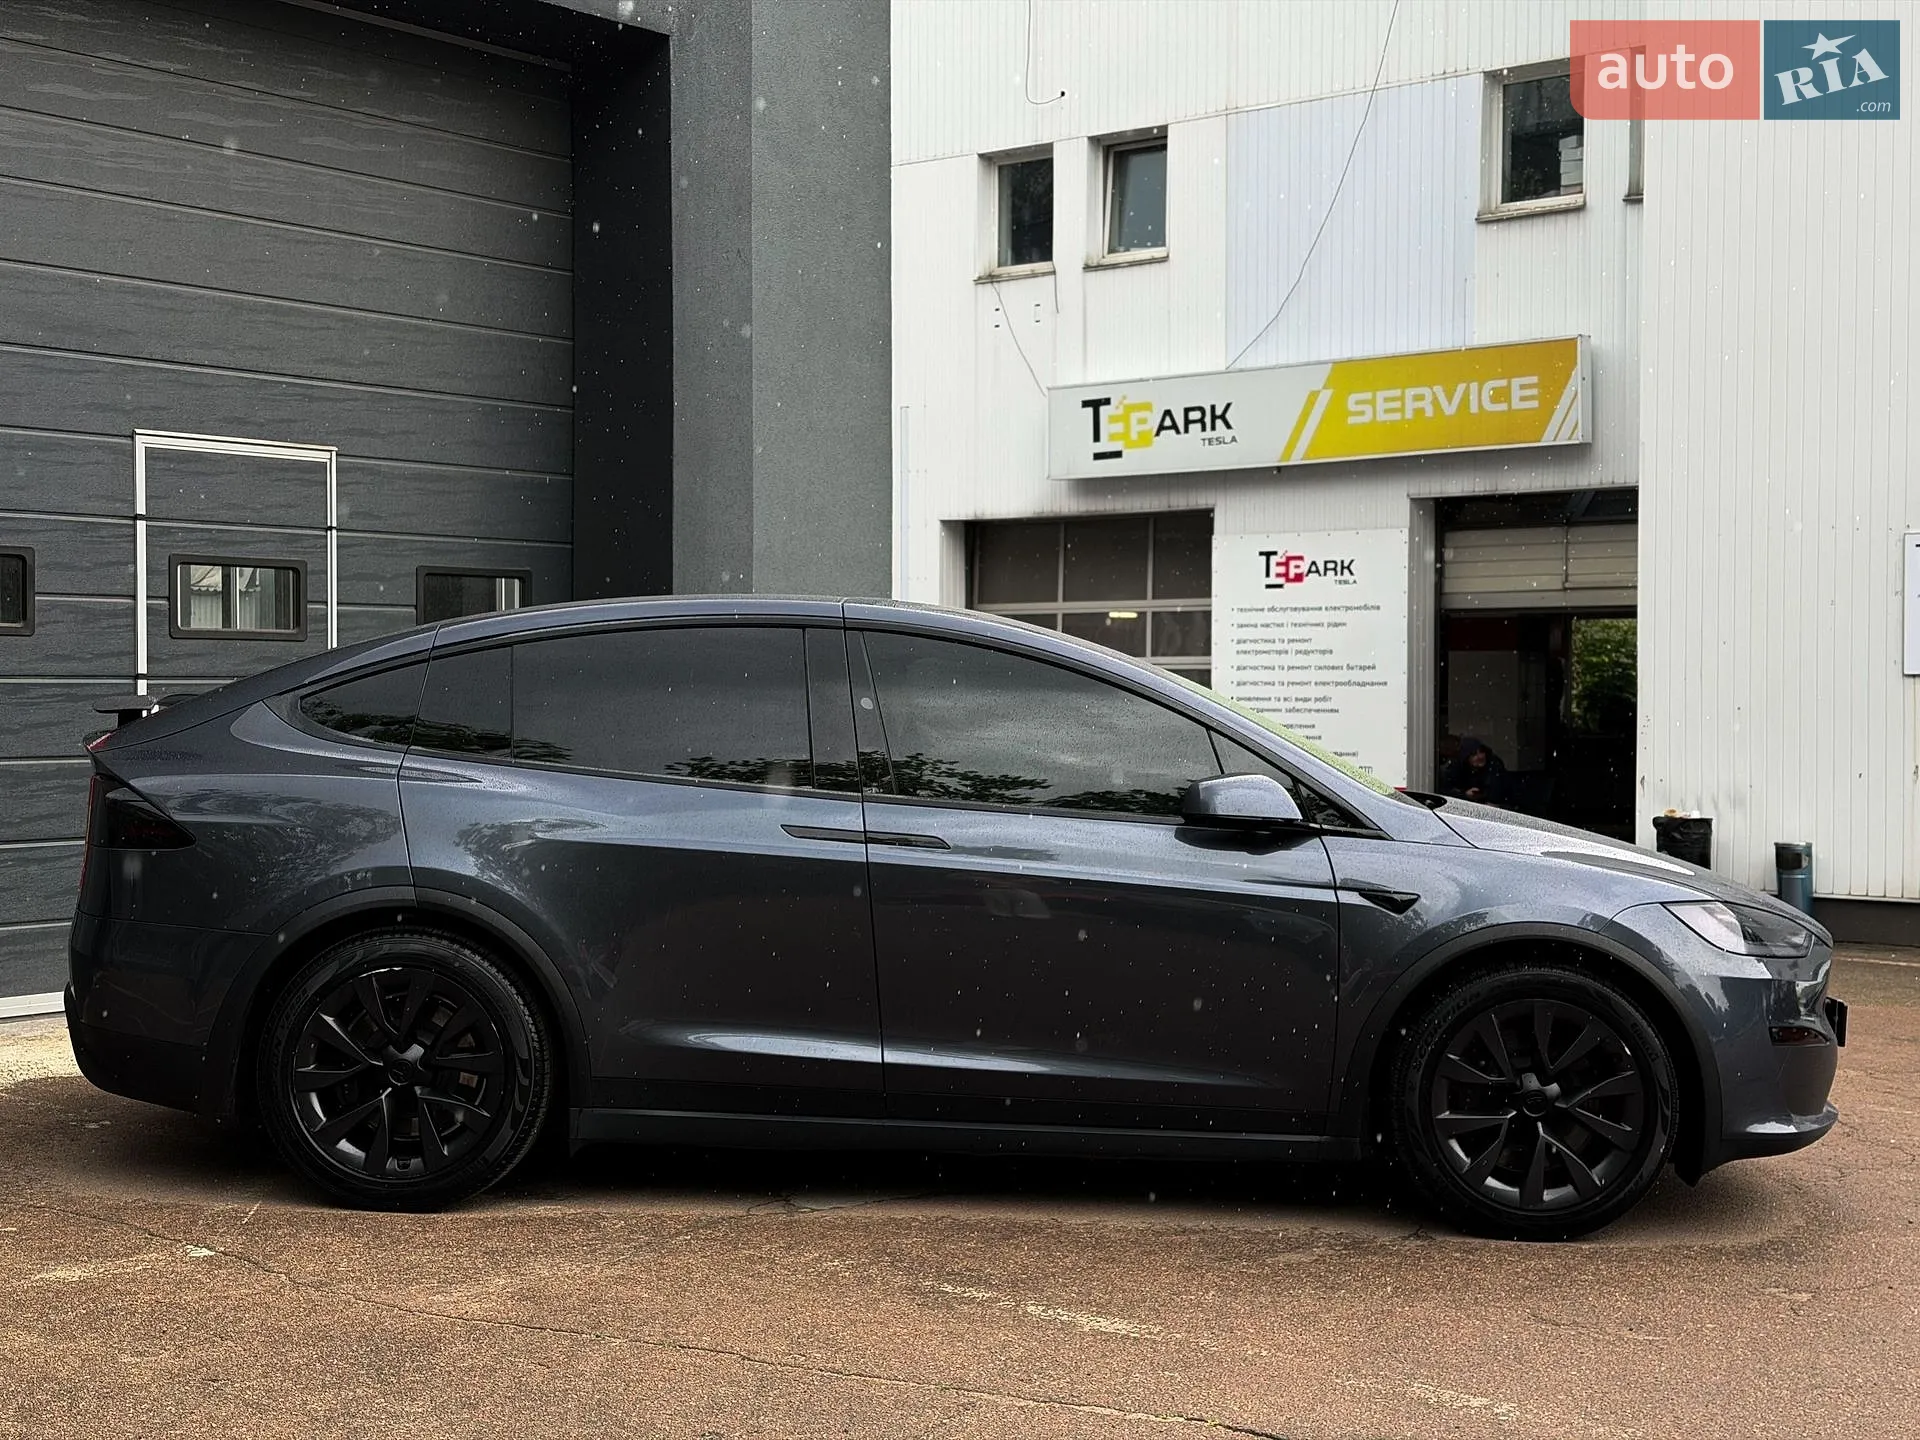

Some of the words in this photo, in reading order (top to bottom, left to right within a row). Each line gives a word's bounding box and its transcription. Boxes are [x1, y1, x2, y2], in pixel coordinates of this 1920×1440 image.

[1347, 375, 1540, 426] SERVICE
[1201, 434, 1238, 448] TESLA
[1236, 637, 1276, 645] діагностика
[1287, 637, 1312, 645] ремонт
[1236, 664, 1276, 672] діагностика
[1287, 664, 1312, 672] ремонт
[1346, 663, 1377, 672] батарей
[1236, 680, 1276, 688] діагностика
[1287, 680, 1312, 688] ремонт
[1314, 679, 1388, 688] електрообладнання
[1295, 696, 1312, 704] види
[1313, 695, 1333, 704] робіт
